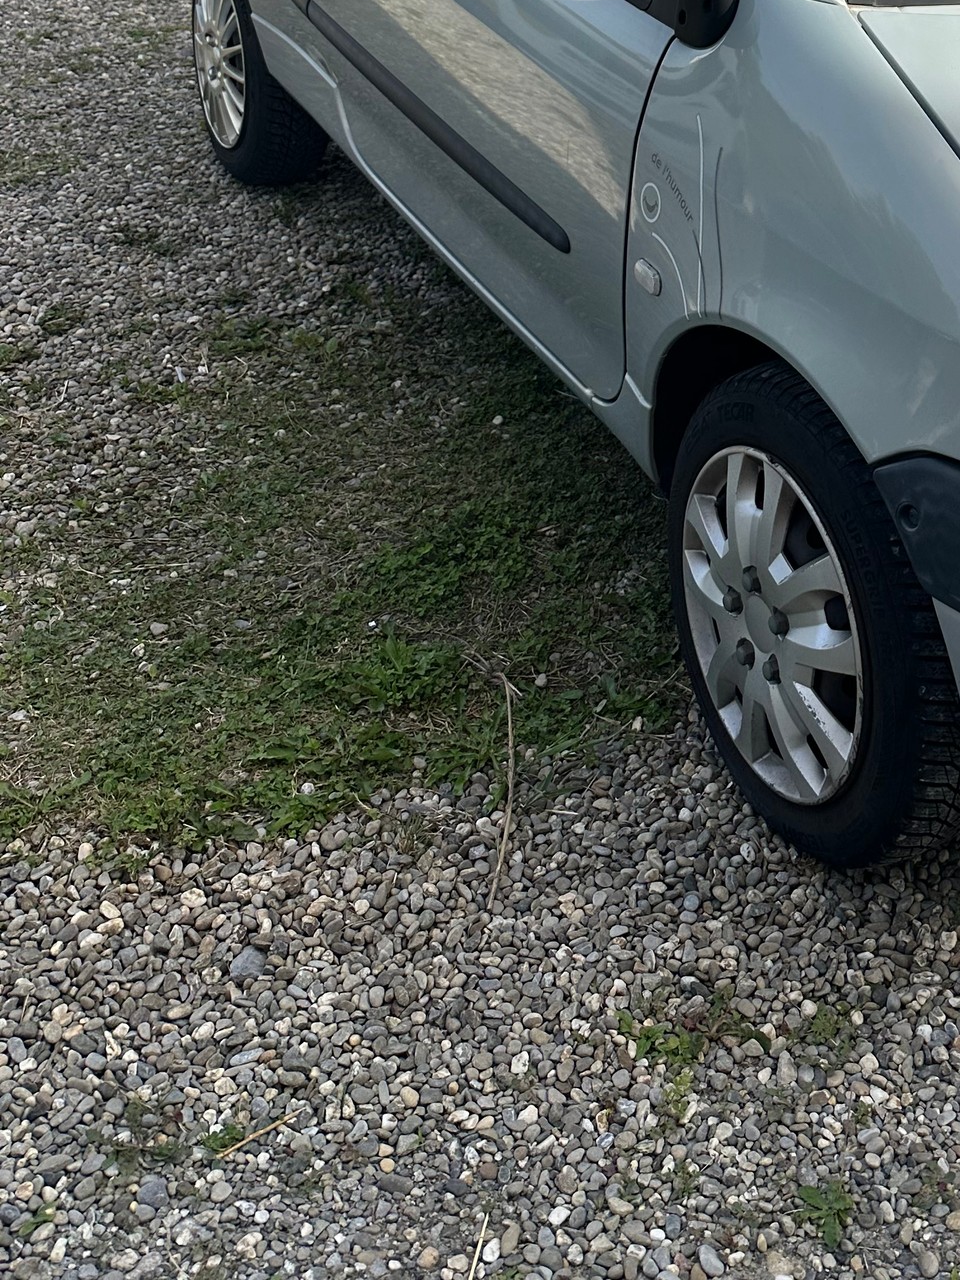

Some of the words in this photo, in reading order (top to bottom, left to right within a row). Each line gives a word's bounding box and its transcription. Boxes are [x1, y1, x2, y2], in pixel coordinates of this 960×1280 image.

[651, 153, 662, 169] de
[662, 164, 694, 221] l'humour
[716, 401, 755, 424] TECAR
